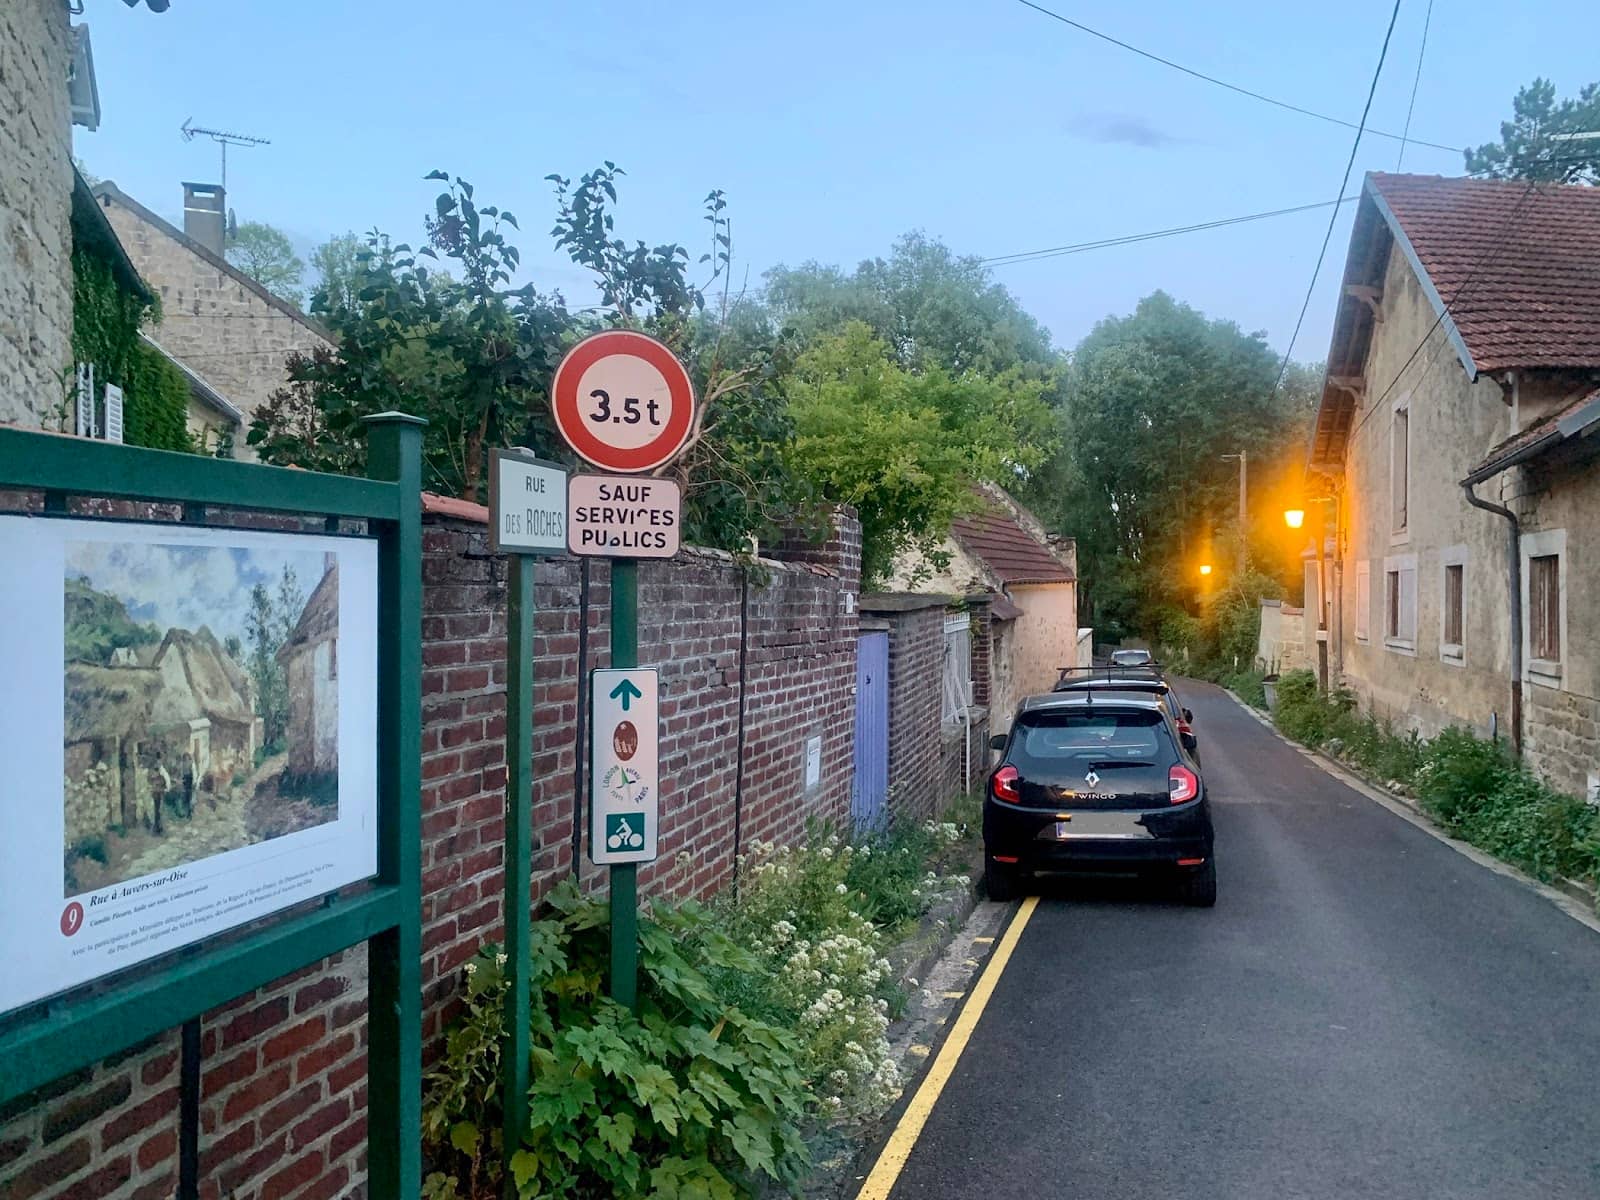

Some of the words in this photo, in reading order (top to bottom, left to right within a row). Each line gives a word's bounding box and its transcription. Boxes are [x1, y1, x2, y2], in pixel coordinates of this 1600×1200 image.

[525, 476, 546, 493] RUE
[599, 484, 652, 502] SAUF
[505, 513, 521, 534] DES
[526, 508, 563, 538] ROCHES
[602, 764, 619, 788] LONDON
[634, 786, 649, 804] PARIS
[90, 894, 109, 907] Rue
[111, 889, 118, 900] à
[119, 870, 188, 897] Auvers-sur-Oise
[68, 908, 78, 930] 9
